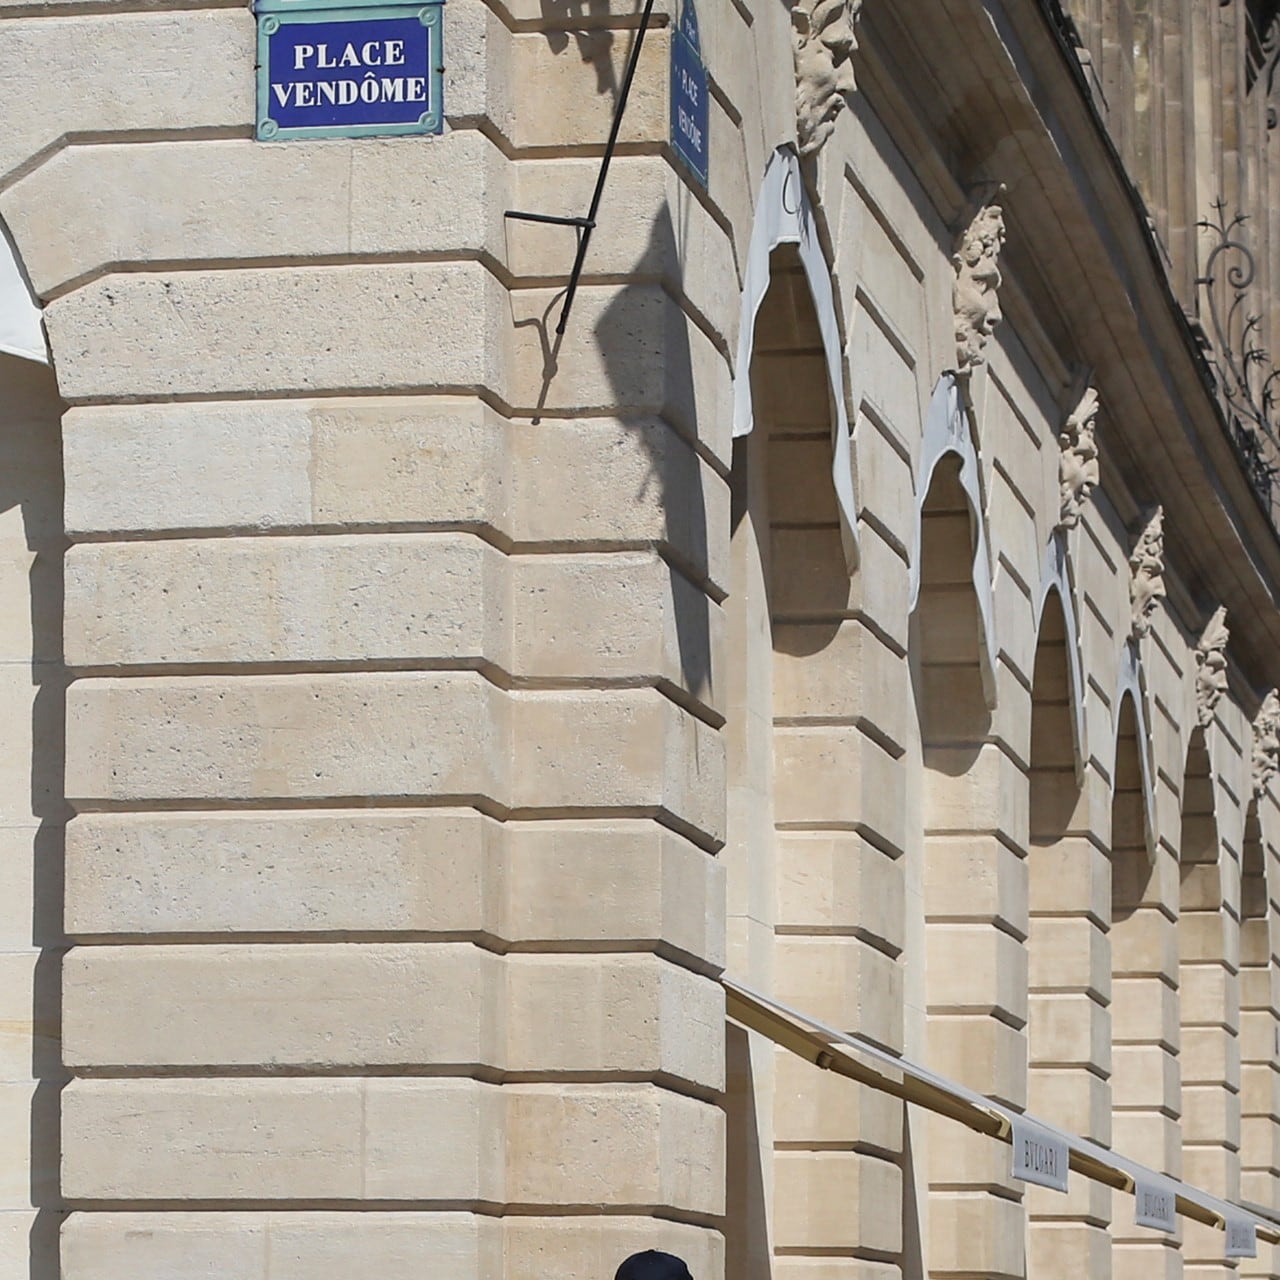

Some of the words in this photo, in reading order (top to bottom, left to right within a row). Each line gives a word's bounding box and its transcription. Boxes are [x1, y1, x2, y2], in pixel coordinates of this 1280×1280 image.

[293, 40, 405, 70] PLACE
[271, 72, 427, 108] VENDÔME
[681, 69, 698, 106] PLACE
[678, 105, 701, 153] VENDÔME
